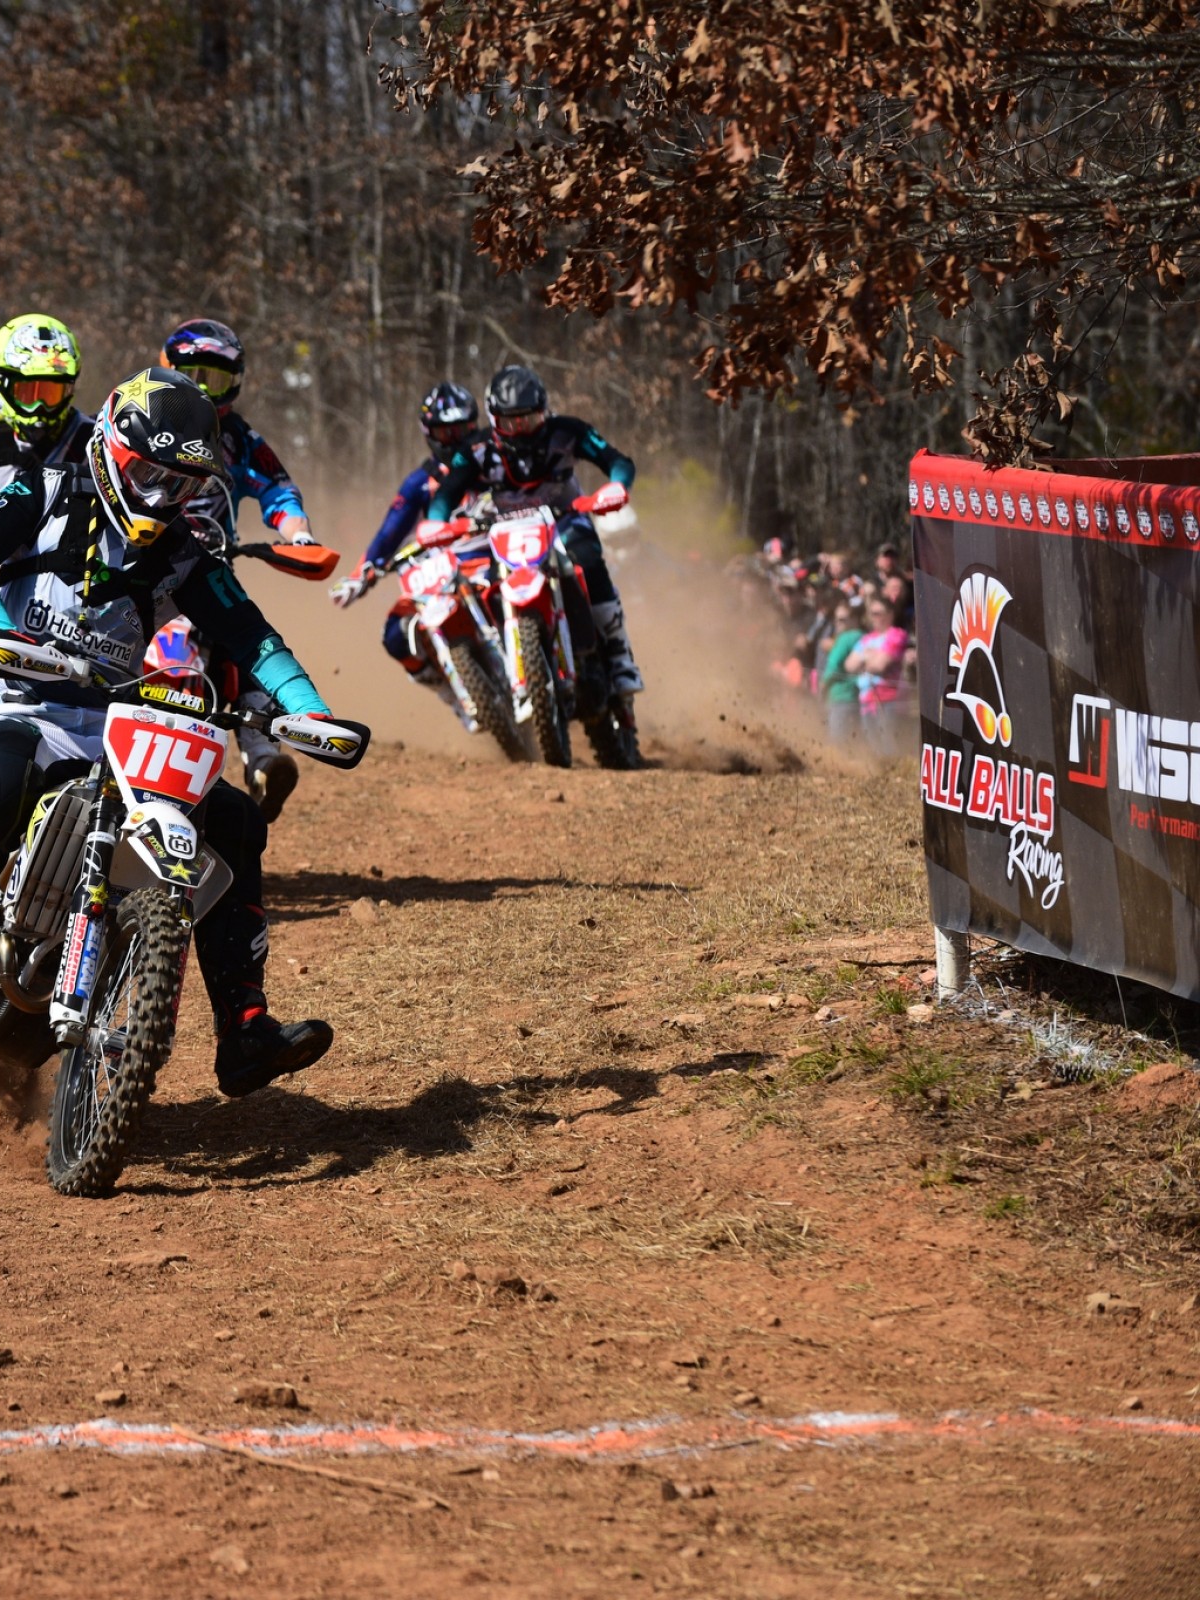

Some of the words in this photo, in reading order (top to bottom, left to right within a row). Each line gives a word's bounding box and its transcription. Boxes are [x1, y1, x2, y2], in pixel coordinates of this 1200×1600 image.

[507, 527, 542, 562] 5
[49, 614, 132, 661] Husqvarna
[124, 729, 217, 796] 114
[187, 722, 215, 738] AMA
[921, 743, 963, 813] ALL
[967, 754, 1054, 837] BALLS
[1007, 821, 1065, 910] Racing
[55, 912, 76, 998] DUNLOP
[62, 913, 88, 994] BRAKING
